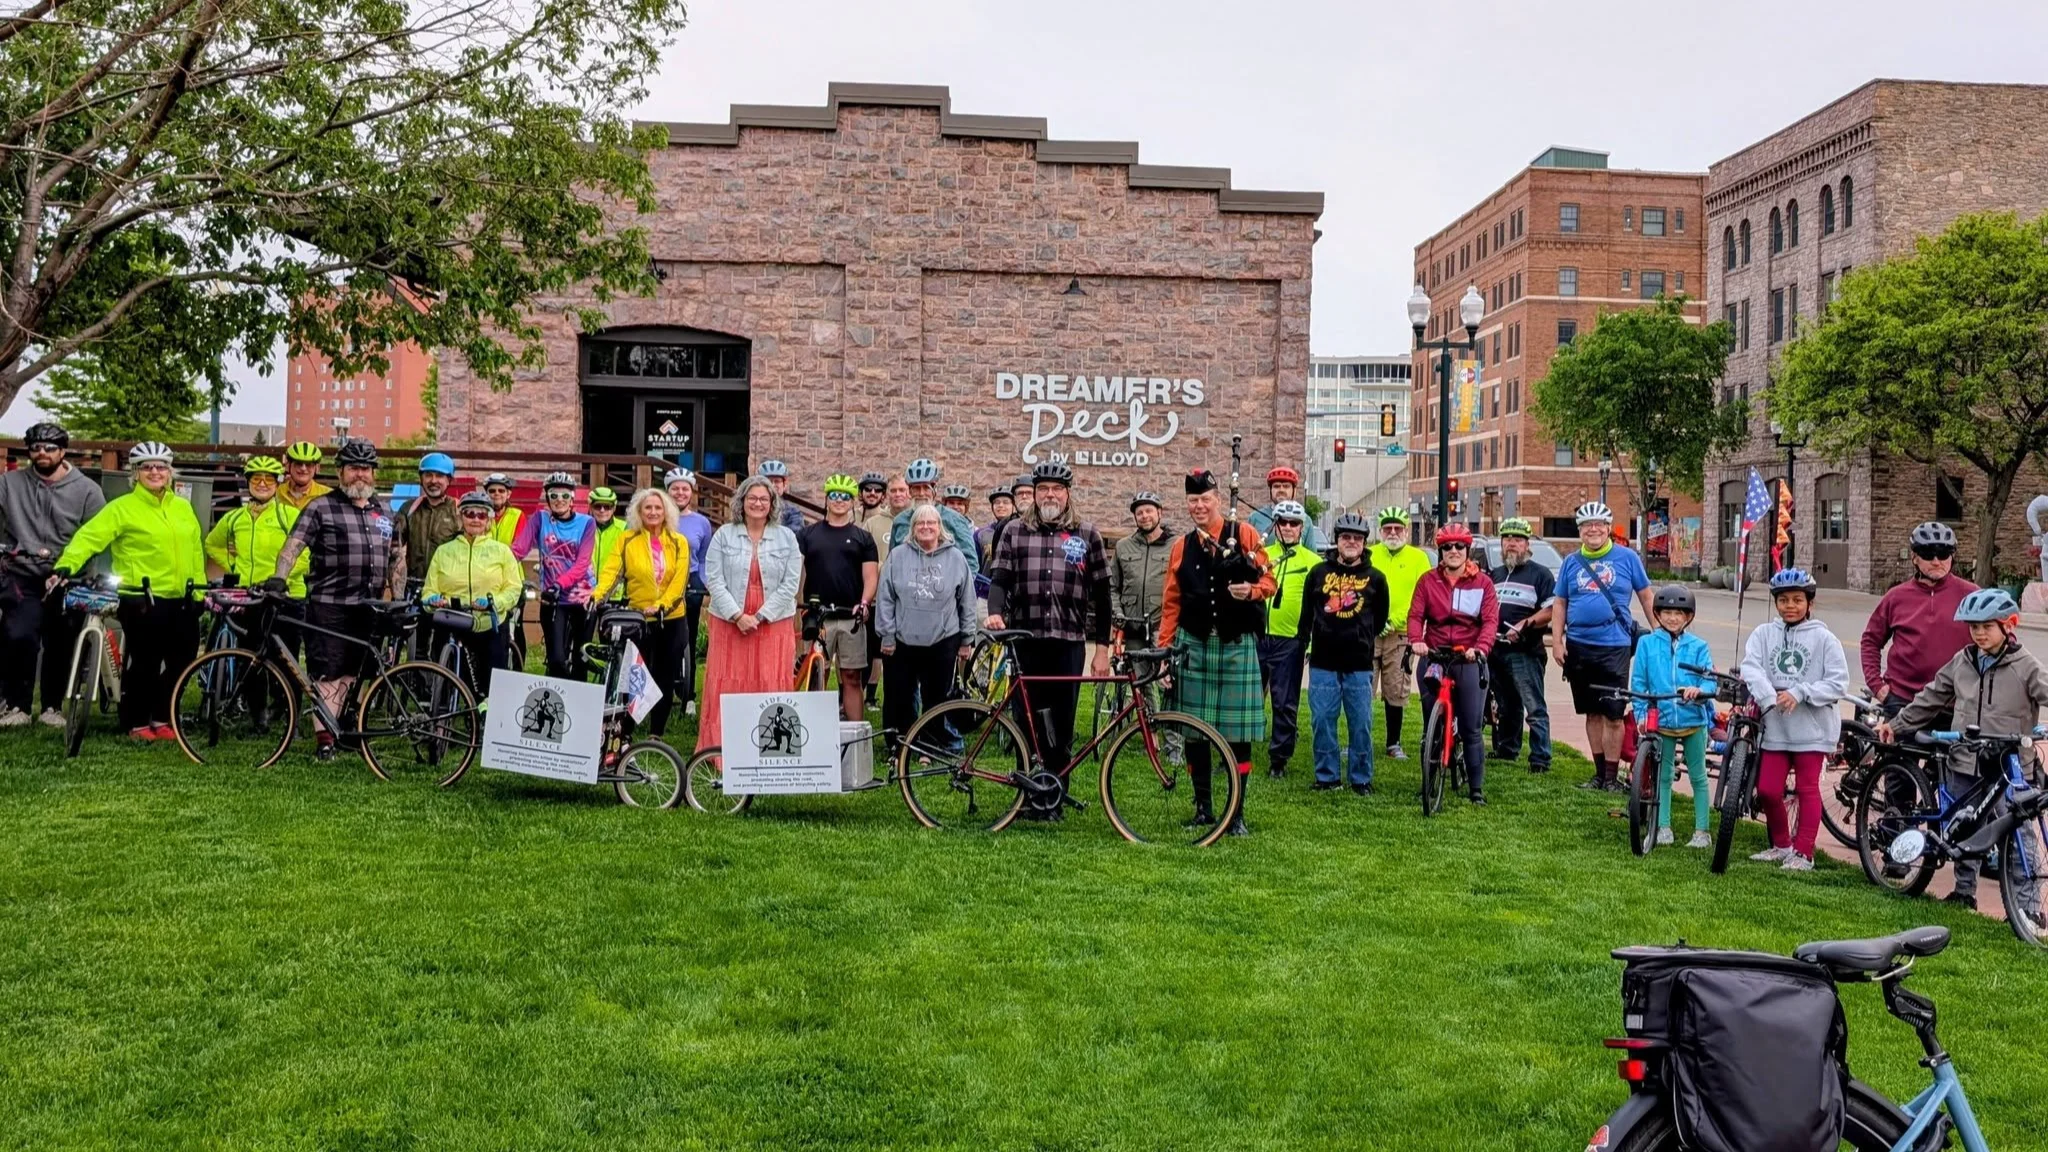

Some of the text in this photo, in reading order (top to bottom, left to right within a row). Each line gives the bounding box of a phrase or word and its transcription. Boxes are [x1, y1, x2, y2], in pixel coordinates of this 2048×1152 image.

[996, 372, 1205, 405] DREAMER'S
[648, 434, 690, 442] STARTUP
[1022, 398, 1179, 464] Deck
[1050, 450, 1149, 466] by LLOYD
[527, 680, 567, 696] RIDE OF
[759, 696, 800, 710] RIDE OF
[519, 739, 562, 751] SILENCE
[1972, 780, 2000, 820] TREK
